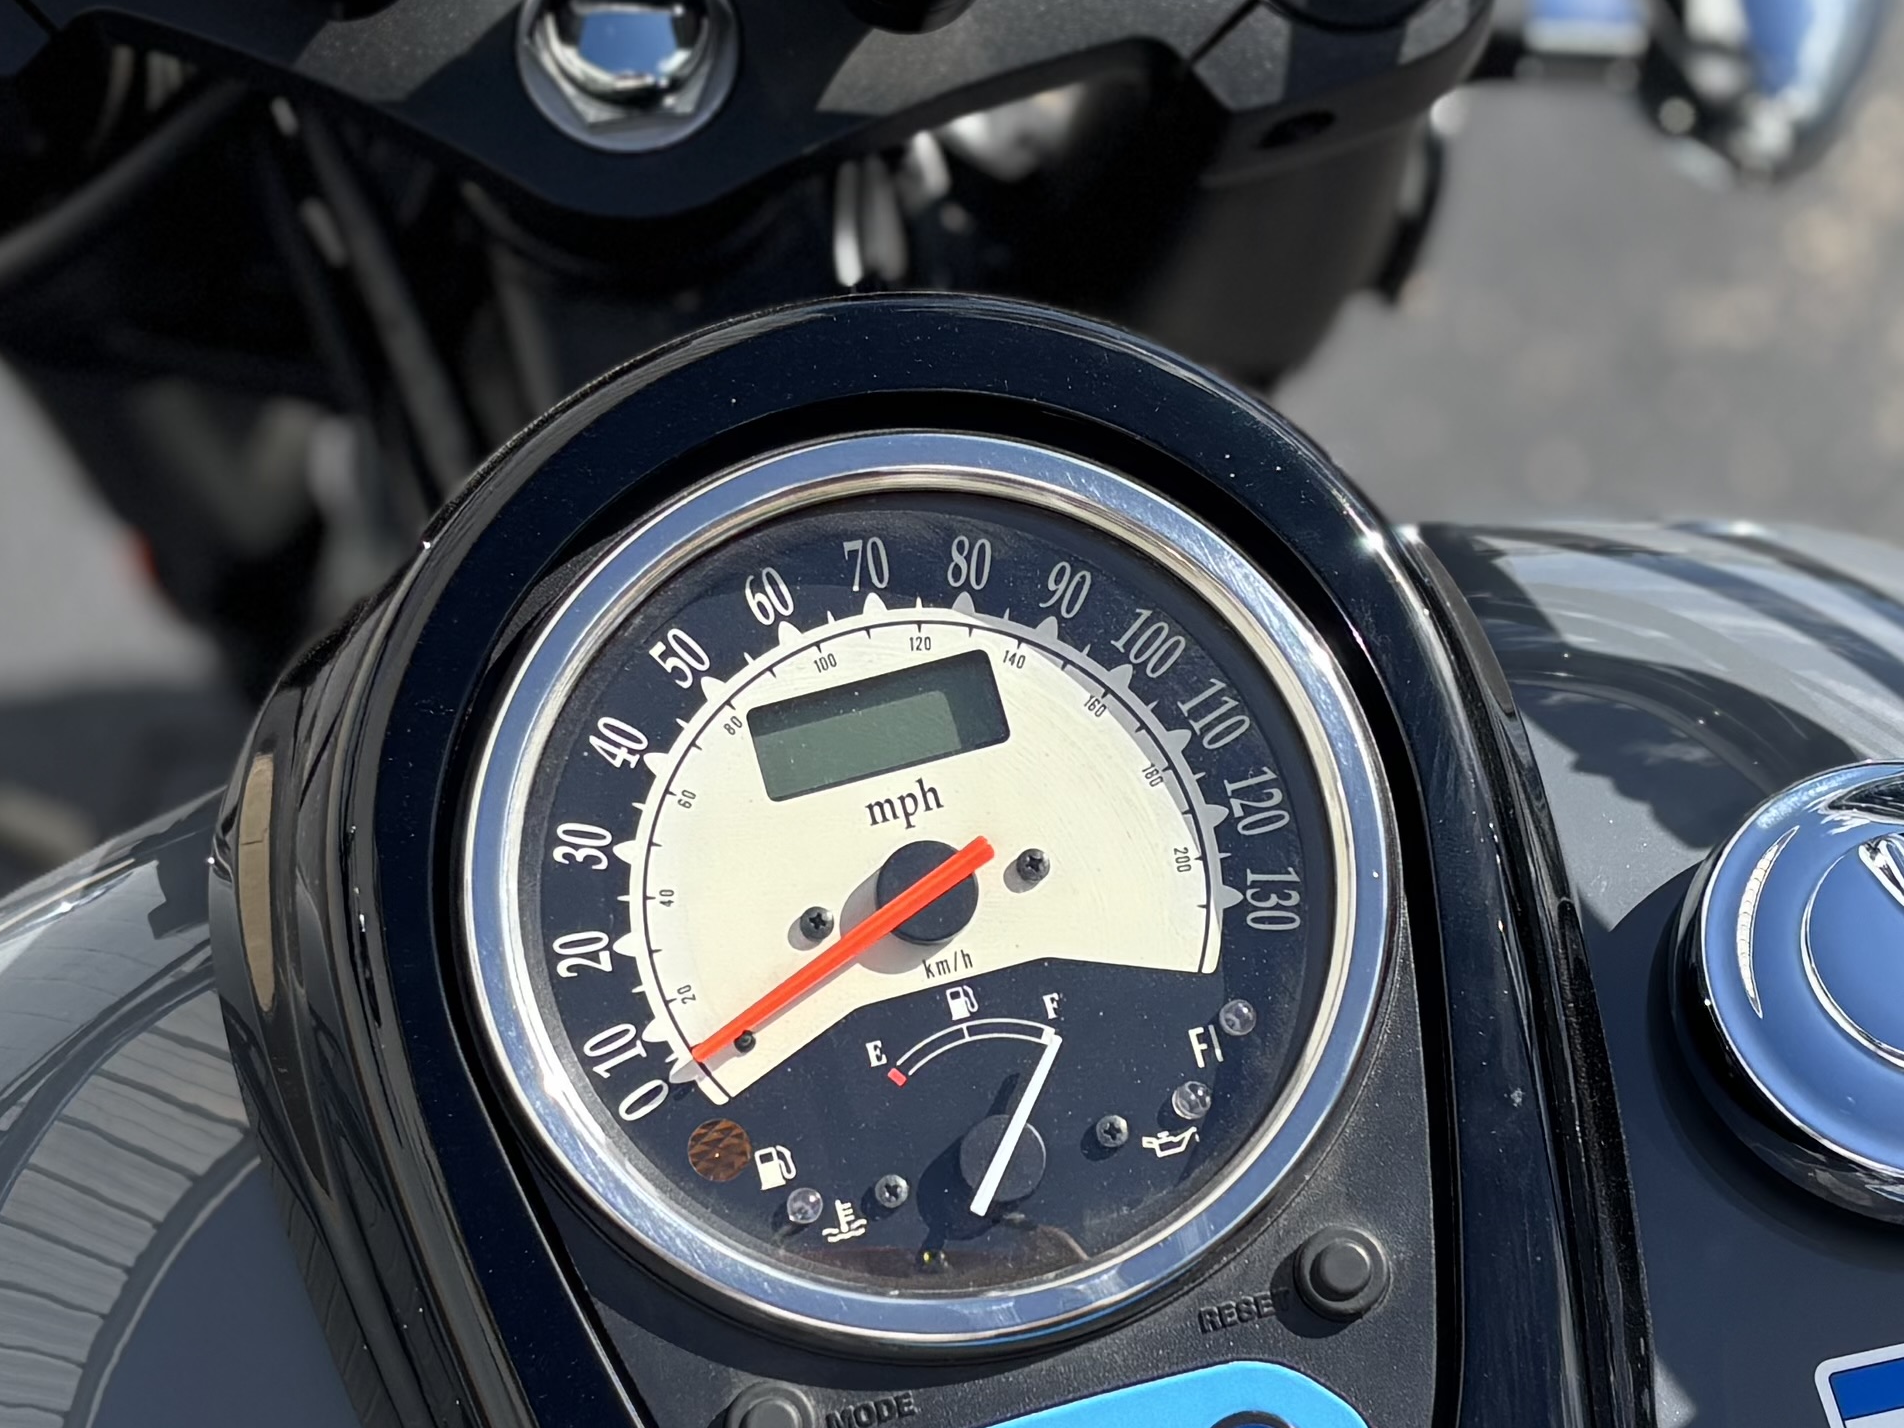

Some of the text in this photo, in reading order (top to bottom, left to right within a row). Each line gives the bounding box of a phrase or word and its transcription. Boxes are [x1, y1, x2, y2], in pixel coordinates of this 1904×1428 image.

[843, 537, 889, 591] 70
[947, 535, 991, 590] 80
[745, 567, 794, 625] 60
[1039, 561, 1091, 618] 90
[649, 628, 710, 689] 50
[814, 653, 837, 673] 100
[909, 637, 932, 651] 120
[1003, 650, 1025, 669] 140
[1110, 608, 1186, 678] 100
[724, 715, 742, 735] 80
[1084, 694, 1107, 717] 160
[1177, 678, 1250, 750] 110
[589, 717, 648, 768] 40
[1142, 762, 1164, 787] 180
[678, 790, 696, 808] 60
[865, 778, 945, 826] mph
[1224, 767, 1290, 835] 120
[553, 823, 612, 870] 30
[1174, 847, 1191, 873] 200
[659, 889, 674, 907] 40
[1246, 867, 1301, 931] 130
[553, 931, 612, 978] 20
[922, 949, 973, 979] km/h
[677, 984, 696, 1004] 20
[1042, 992, 1061, 1019] F
[583, 1024, 647, 1078] 10
[866, 1040, 887, 1067] E
[1188, 1025, 1224, 1068] FI
[619, 1079, 669, 1121] 0
[1198, 1287, 1289, 1335] RESET
